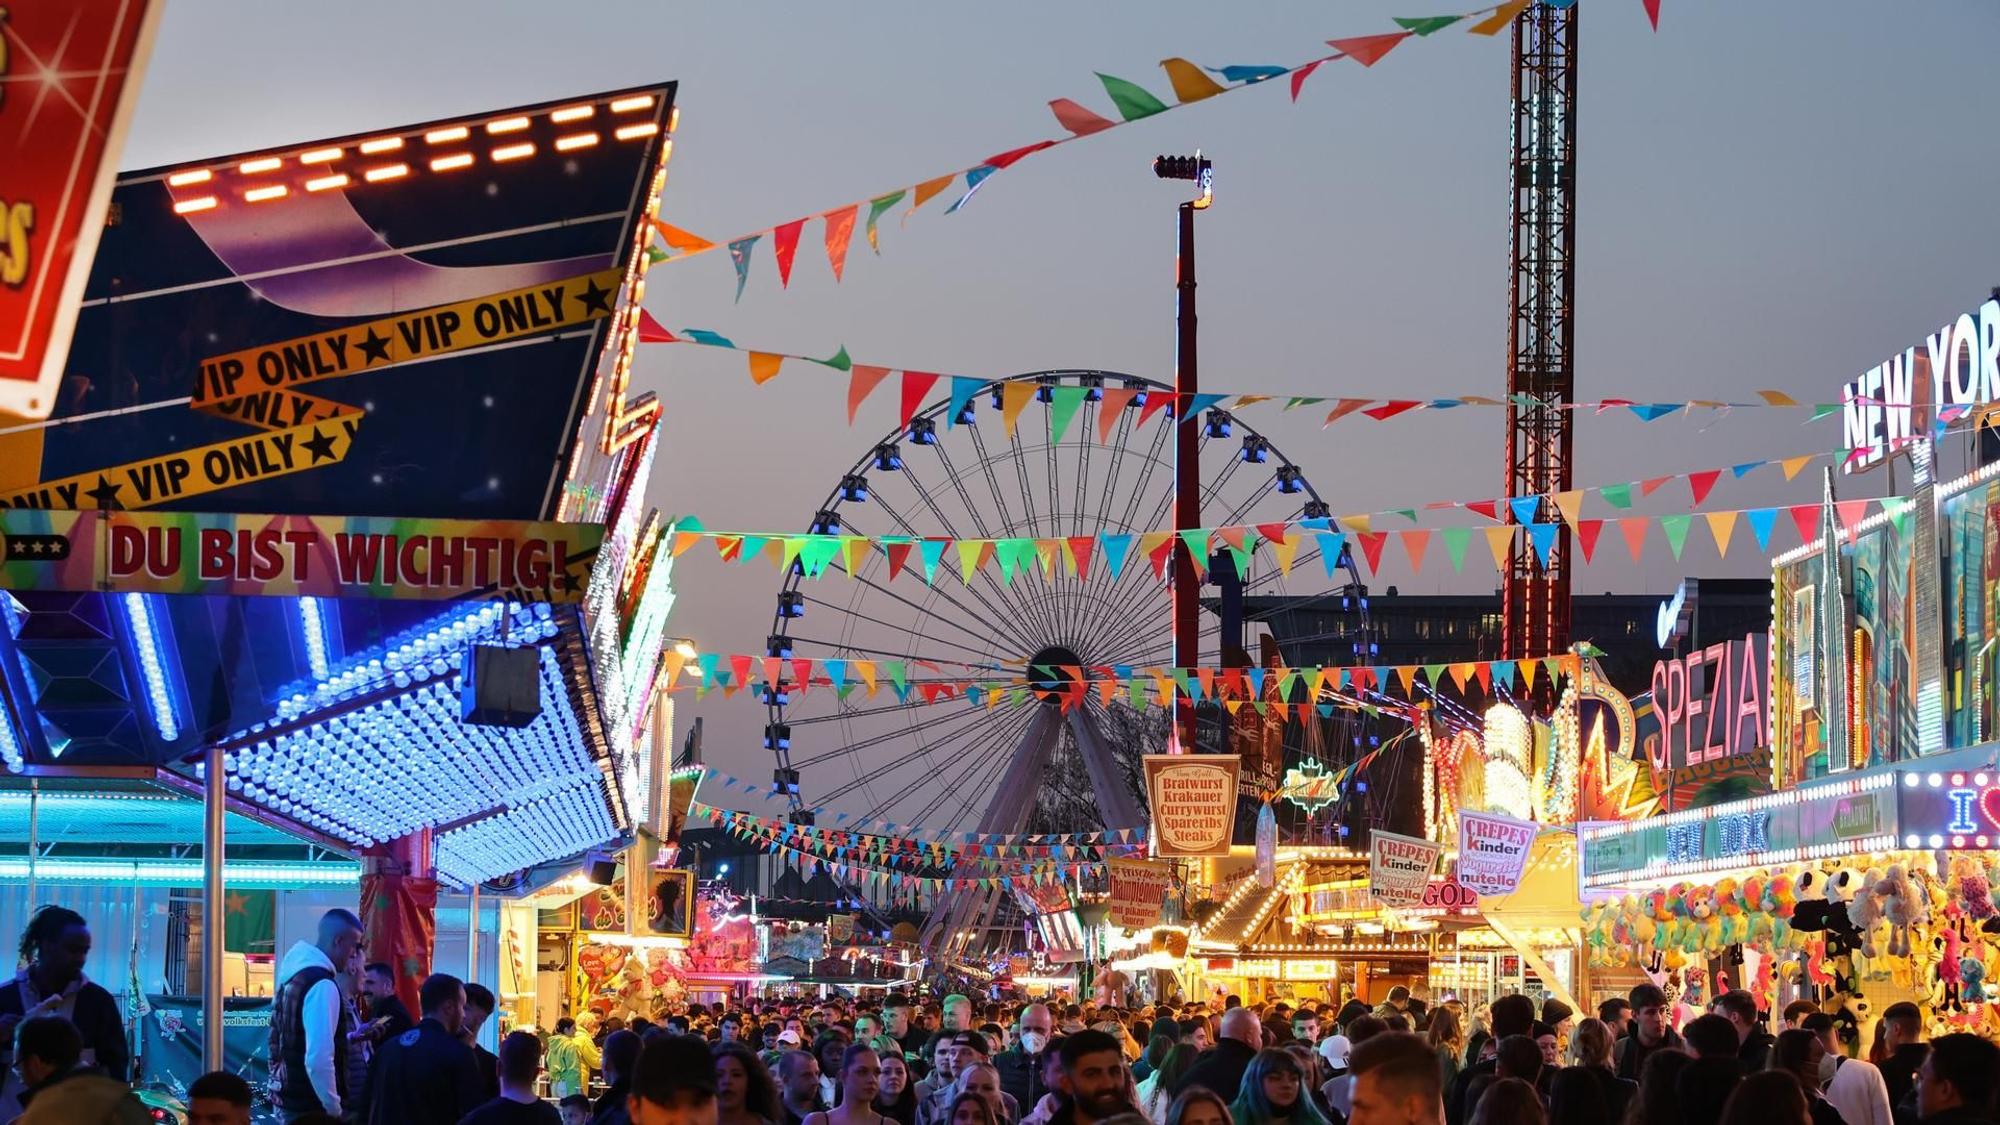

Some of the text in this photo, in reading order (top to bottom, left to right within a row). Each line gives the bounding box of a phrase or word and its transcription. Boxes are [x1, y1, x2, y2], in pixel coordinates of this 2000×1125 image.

[257, 334, 349, 387] ONLY
[397, 310, 461, 355] VIP
[473, 285, 567, 338] ONLY
[1843, 298, 2000, 476] NEW YOR
[128, 457, 190, 502] VIP
[203, 432, 295, 486] ONLY
[110, 525, 568, 592] DU BIST WICHTIG!
[1162, 778, 1223, 789] Bratwurst
[1164, 791, 1223, 803] Krakauer
[1160, 804, 1227, 817] Currywurst
[1948, 789, 1978, 834] I
[1164, 817, 1223, 830] Spareribs
[1174, 830, 1214, 841] Steaks
[1666, 810, 1769, 865] NEW YORK
[1467, 836, 1521, 855] kinder
[1380, 855, 1428, 872] kinder
[1121, 867, 1156, 879] Frische
[1461, 873, 1517, 887] nutella
[1372, 887, 1422, 900] nutella
[1112, 905, 1157, 918] mit pikanten
